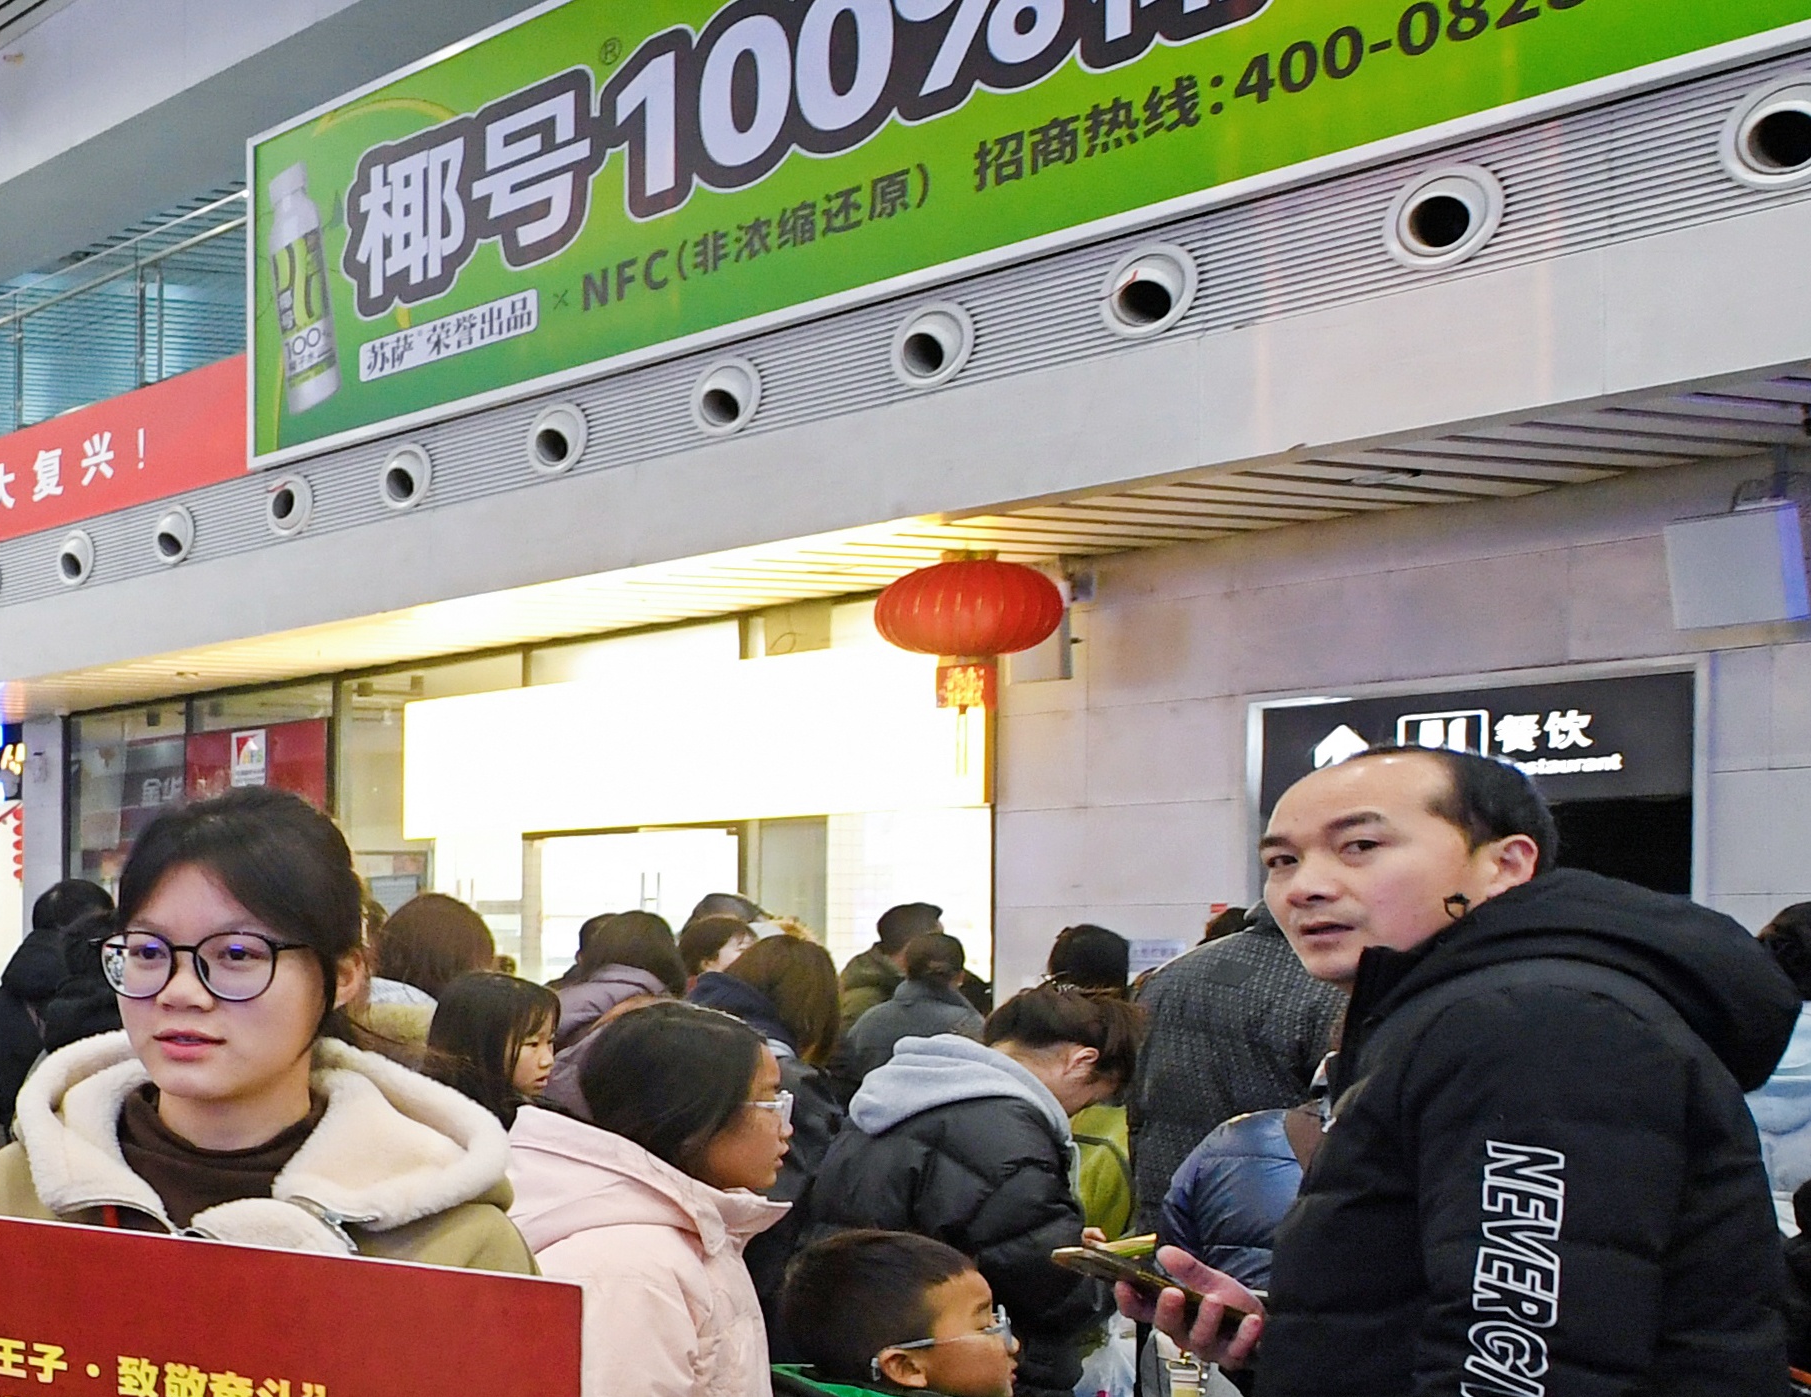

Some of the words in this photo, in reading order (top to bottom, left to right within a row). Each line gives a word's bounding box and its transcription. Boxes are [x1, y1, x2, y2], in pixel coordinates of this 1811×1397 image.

[972, 0, 1591, 193] 招商热线:400-082
[425, 294, 534, 356] 荣誉出品
[1494, 709, 1595, 754] 餐饮
[1511, 752, 1624, 777] estaurant
